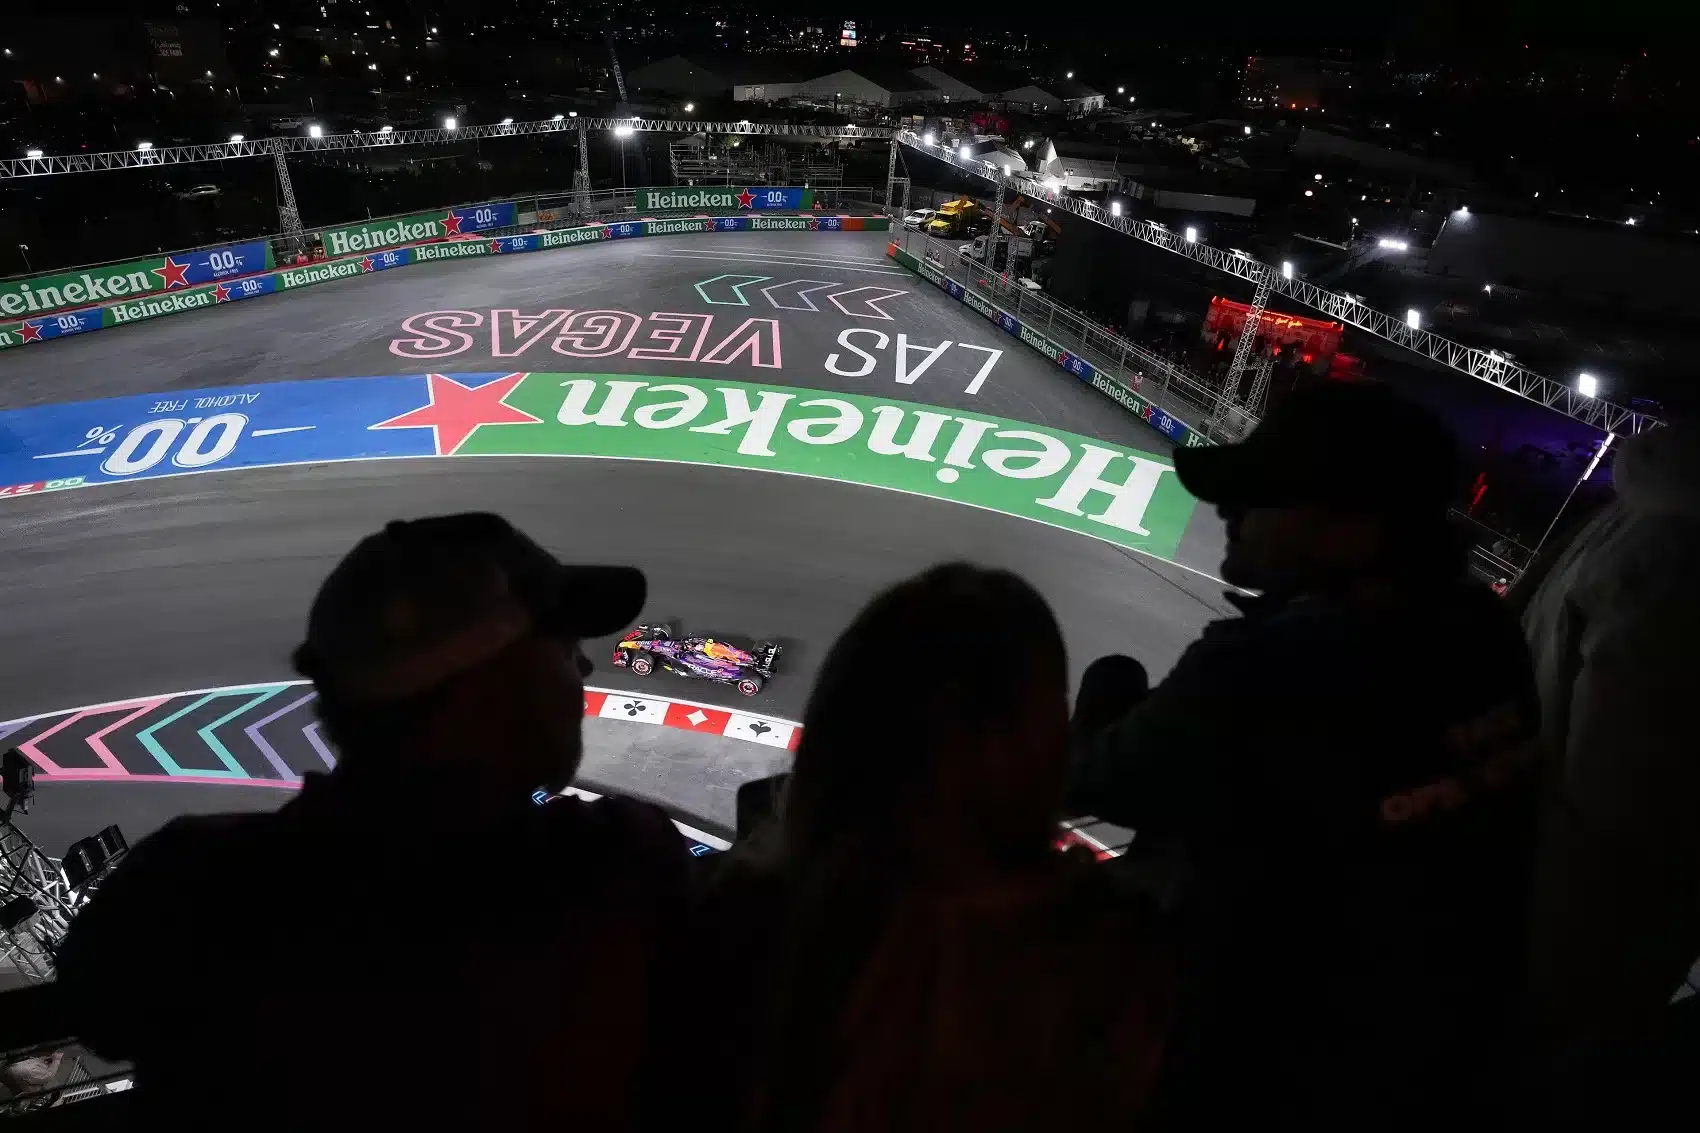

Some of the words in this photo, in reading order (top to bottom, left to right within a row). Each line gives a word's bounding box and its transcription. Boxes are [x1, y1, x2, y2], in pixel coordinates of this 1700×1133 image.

[647, 191, 732, 209] Heineken
[543, 229, 599, 246] Heineken
[648, 220, 702, 234] Heineken
[752, 218, 806, 229] Heineken
[329, 221, 438, 255] Heineken
[415, 243, 486, 260] Heineken
[282, 263, 357, 287] Heineken
[0, 271, 152, 317] eineken
[110, 291, 209, 323] Heineken
[964, 290, 993, 318] Heineken
[390, 308, 783, 370] VEGAS
[1020, 326, 1057, 360] Heineken
[825, 327, 1004, 395] LAS
[148, 399, 188, 414] FREE
[194, 392, 261, 410] ALCOHOL
[1092, 372, 1140, 413] Heineken
[558, 379, 1174, 538] Heineken
